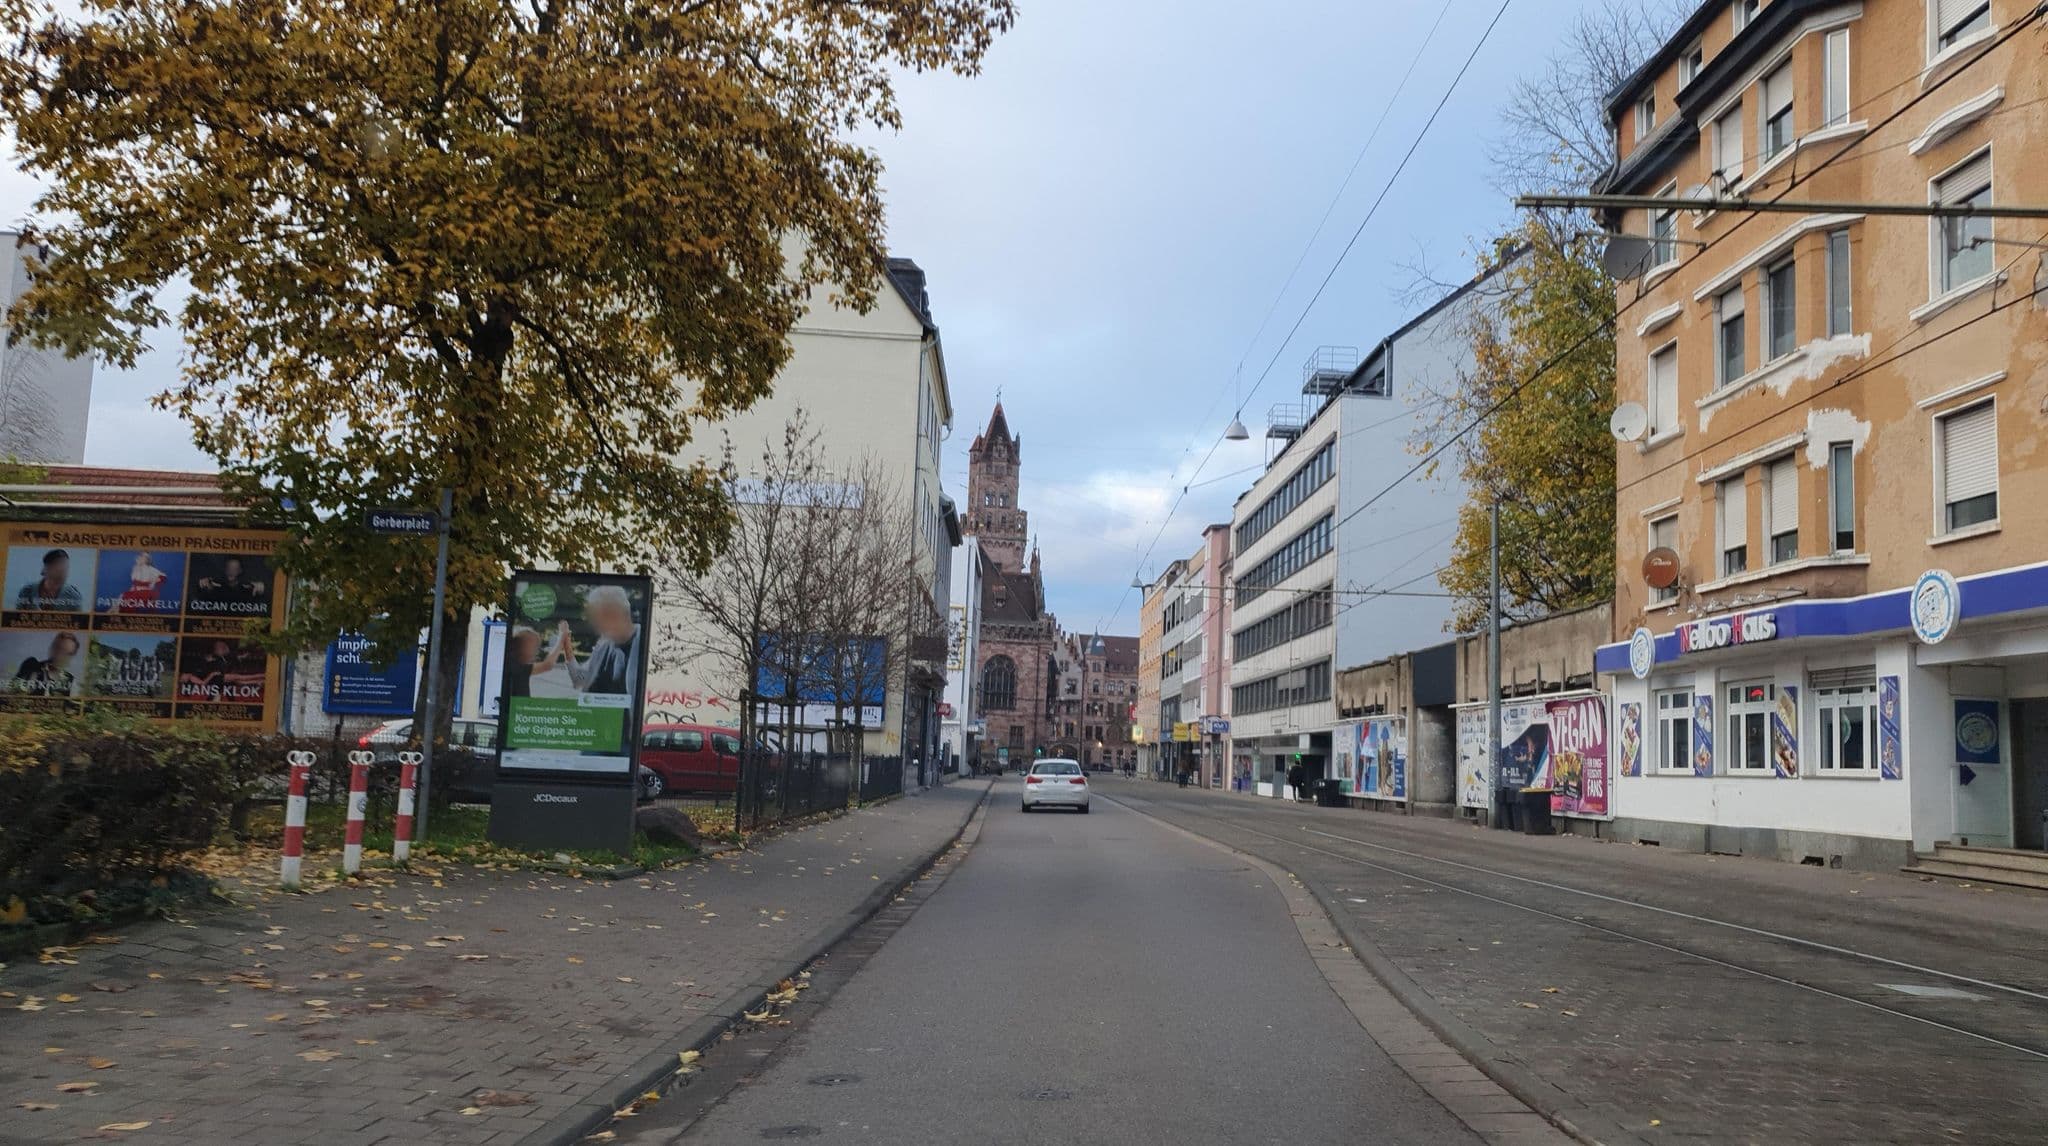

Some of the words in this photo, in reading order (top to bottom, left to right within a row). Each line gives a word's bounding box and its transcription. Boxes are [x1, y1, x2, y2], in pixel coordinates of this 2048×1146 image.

[52, 532, 137, 546] SAAREVENT
[140, 535, 180, 548] GMBH
[97, 597, 145, 609] PATRICIA
[146, 599, 180, 610] KELLY
[1732, 612, 1776, 645] Haus
[181, 683, 220, 697] HANS
[222, 685, 260, 698] KLOK
[515, 713, 559, 725] Kommen
[561, 715, 577, 725] Sie
[514, 725, 530, 734] der
[532, 725, 565, 737] Grippe
[567, 728, 597, 737] zuvor.
[1547, 698, 1603, 755] VEGAN
[533, 793, 578, 803] JCDecaux
